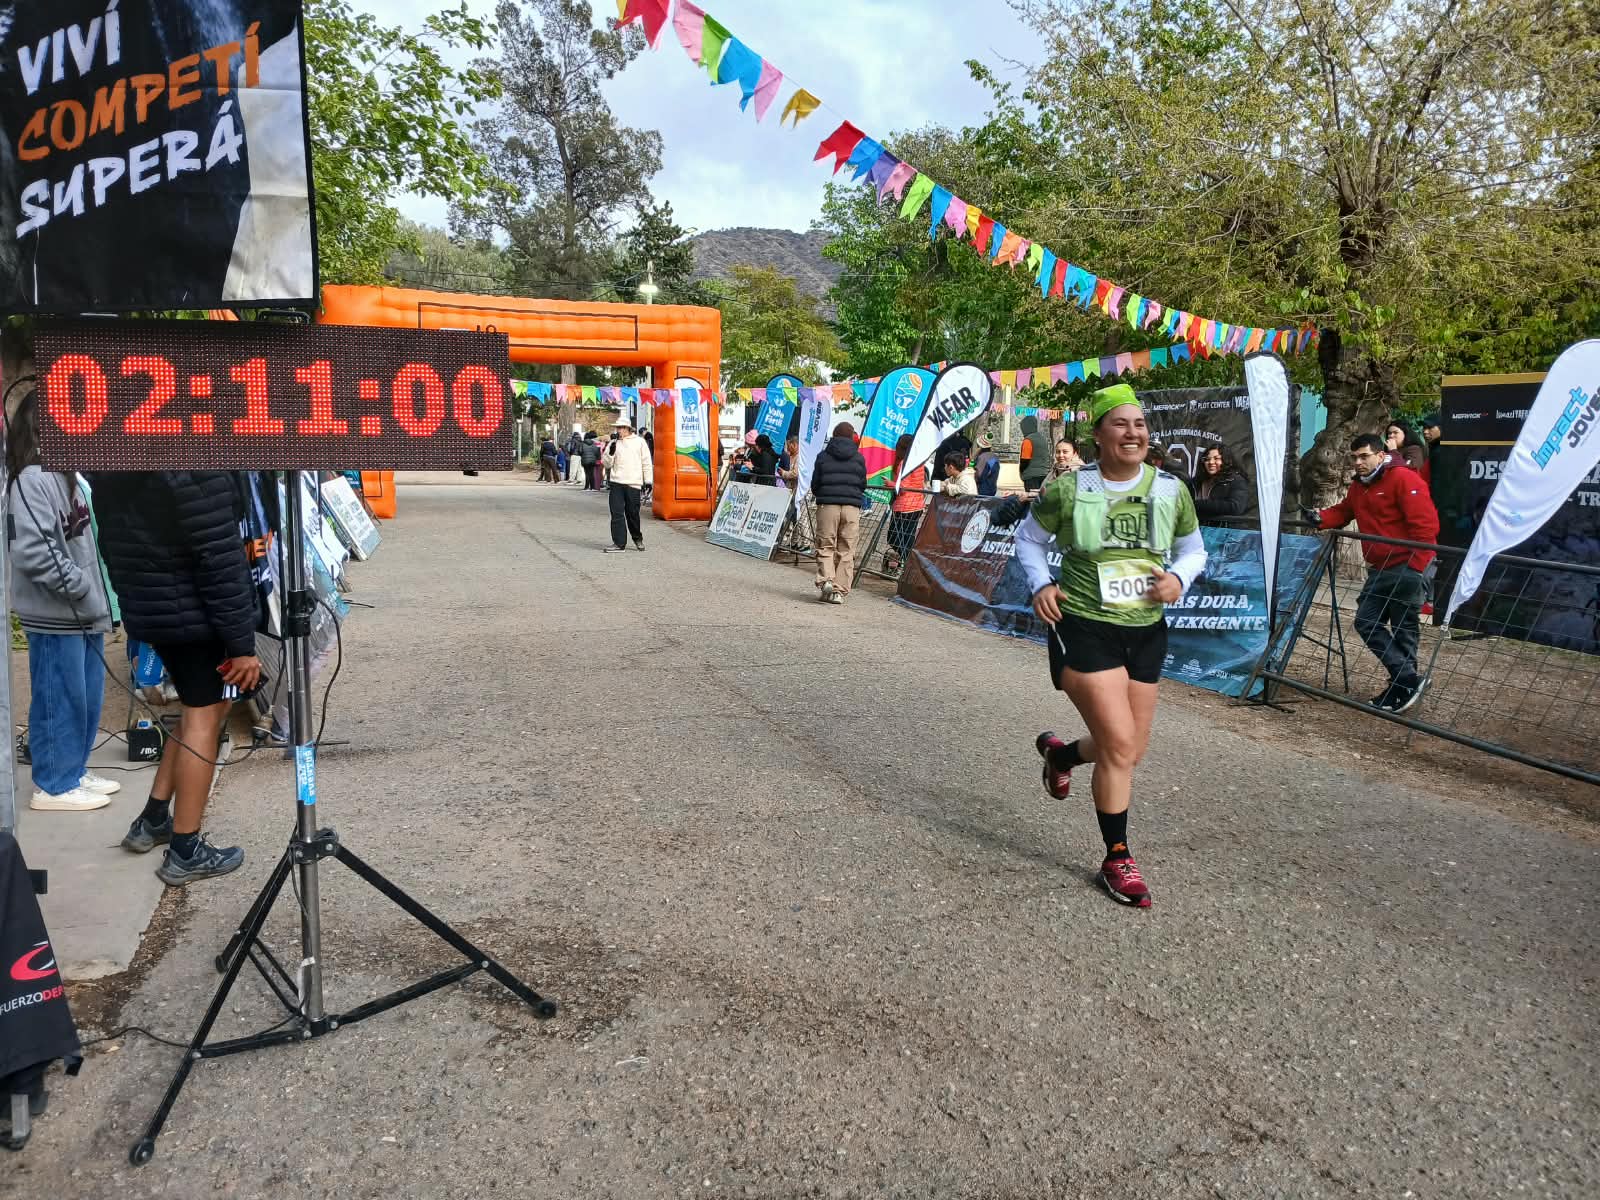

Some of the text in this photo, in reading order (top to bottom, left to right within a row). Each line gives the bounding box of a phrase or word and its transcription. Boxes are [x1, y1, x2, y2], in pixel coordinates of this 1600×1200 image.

[17, 0, 122, 96] VIVÍ
[17, 21, 261, 162] COMPETÍ
[15, 99, 243, 239] SUPERÁ
[46, 353, 504, 438] 02:11:00
[1210, 401, 1231, 409] CENTER
[682, 415, 699, 423] Valle
[768, 406, 785, 419] Valle
[886, 407, 908, 426] Valle
[927, 387, 978, 432] YAFAR
[1568, 387, 1600, 448] JOVE
[981, 540, 1016, 557] ASTICA
[1199, 595, 1253, 611] DURA,
[1175, 615, 1267, 631] EXIGENTE
